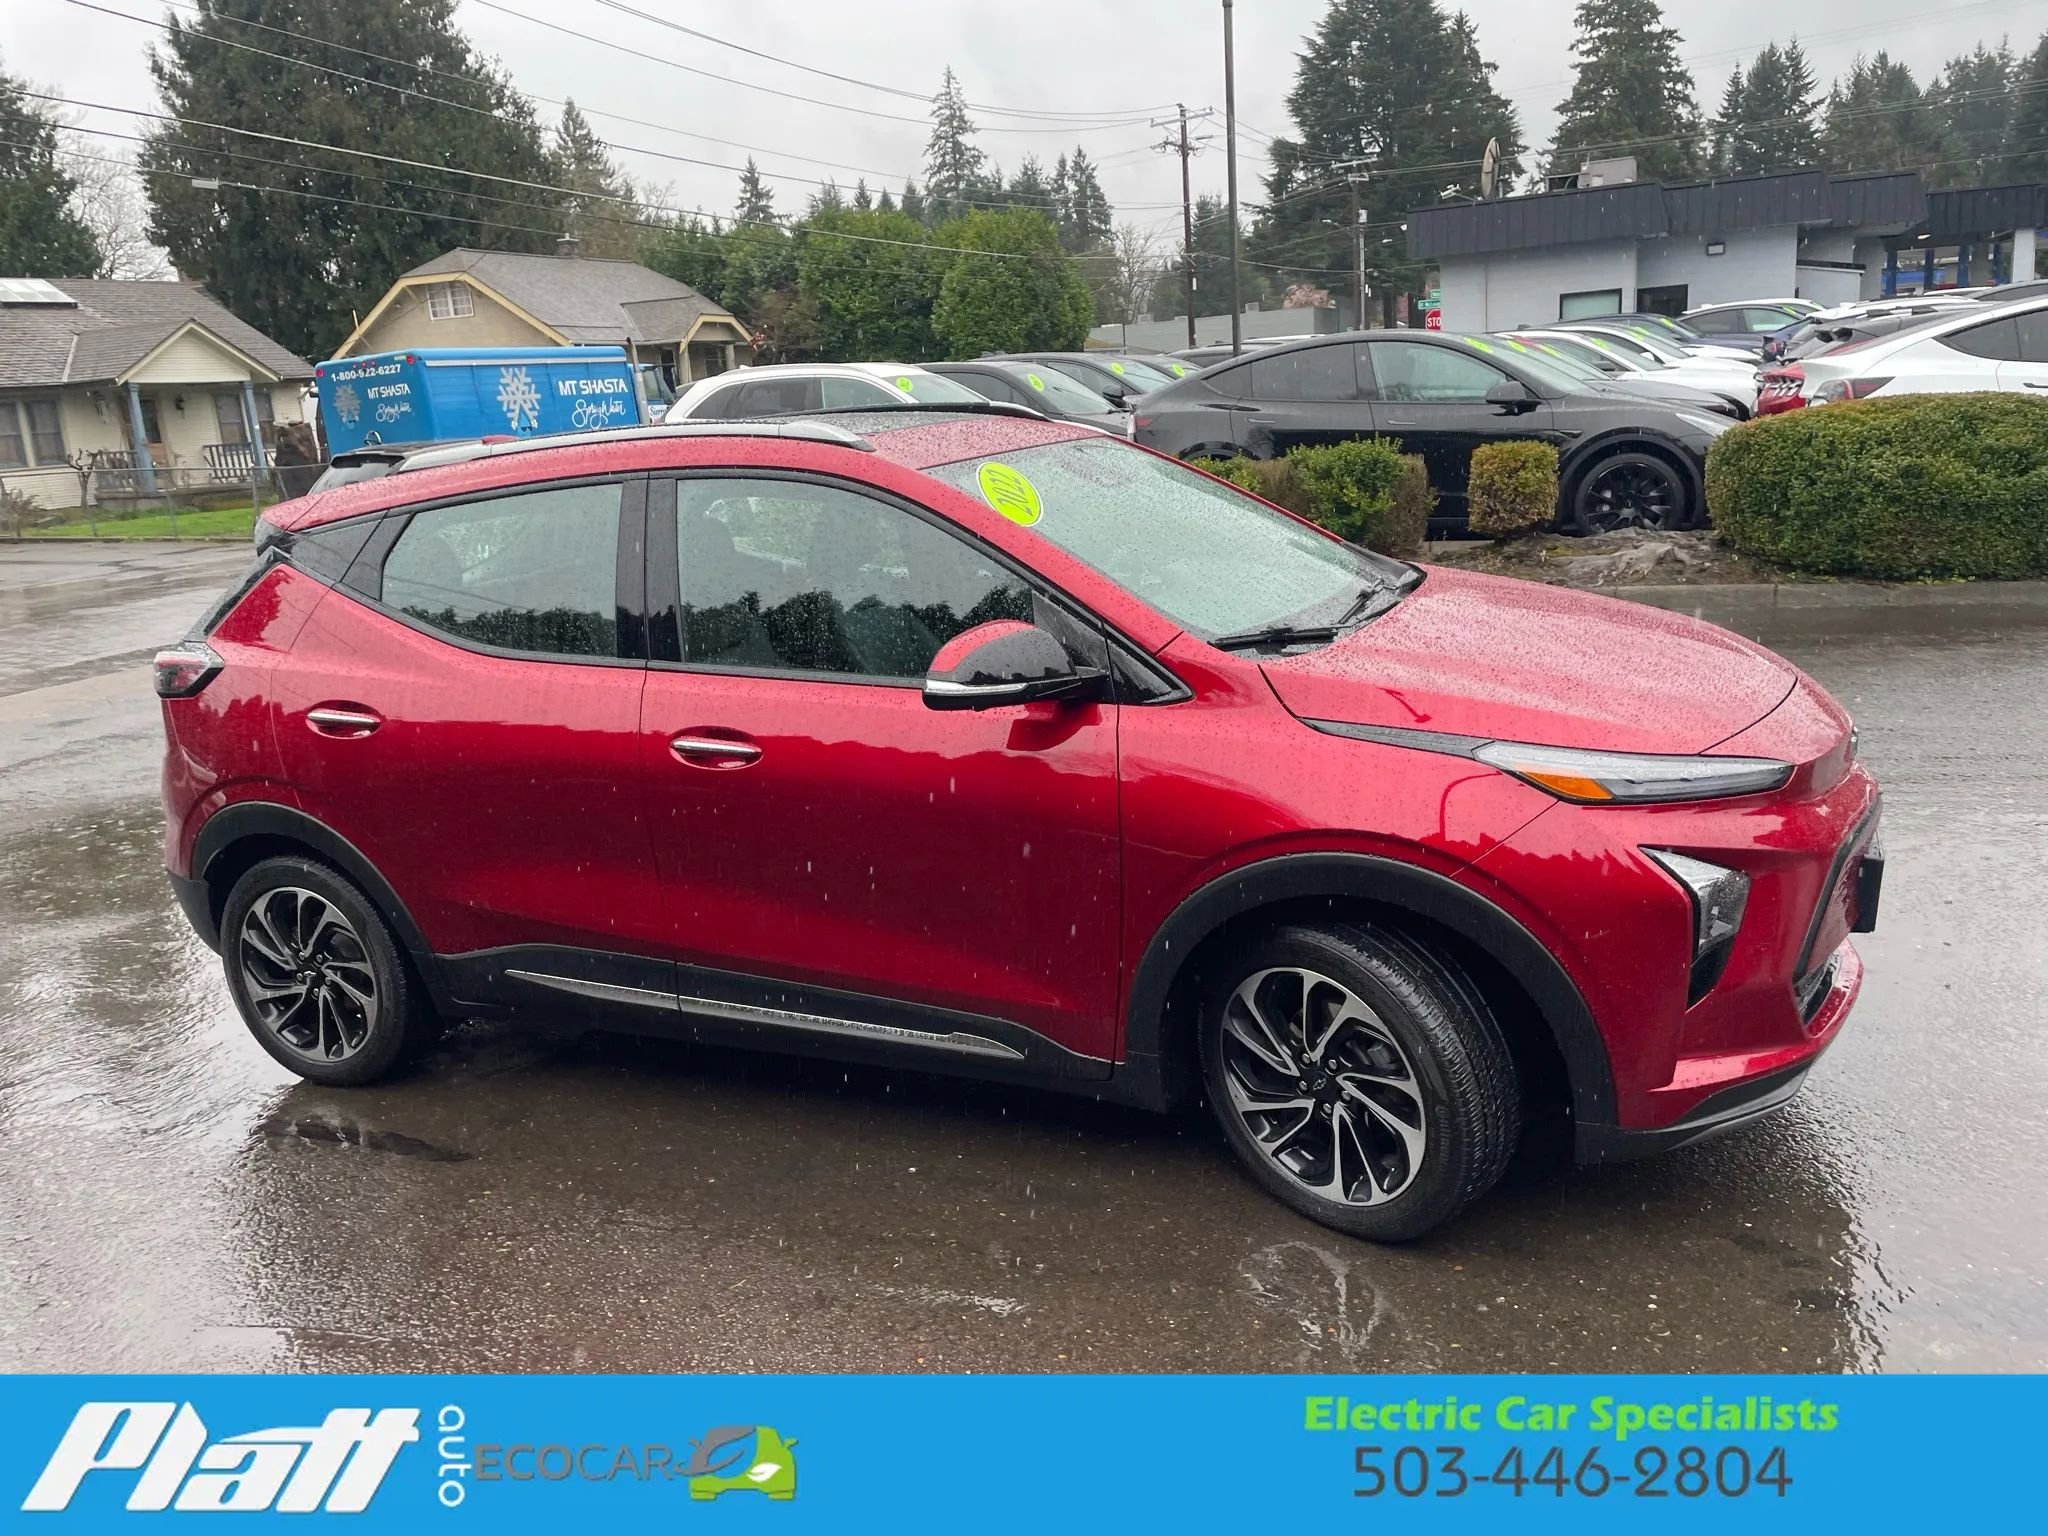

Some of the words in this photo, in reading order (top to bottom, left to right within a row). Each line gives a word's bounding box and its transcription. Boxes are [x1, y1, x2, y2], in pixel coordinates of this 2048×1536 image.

[1427, 317, 1441, 327] STO
[331, 363, 401, 382] 1-800-922-6227
[367, 387, 379, 400] MT
[380, 383, 411, 398] SHASTA
[558, 380, 577, 396] MT
[579, 378, 628, 395] SHASTA
[985, 469, 1033, 516] 2022
